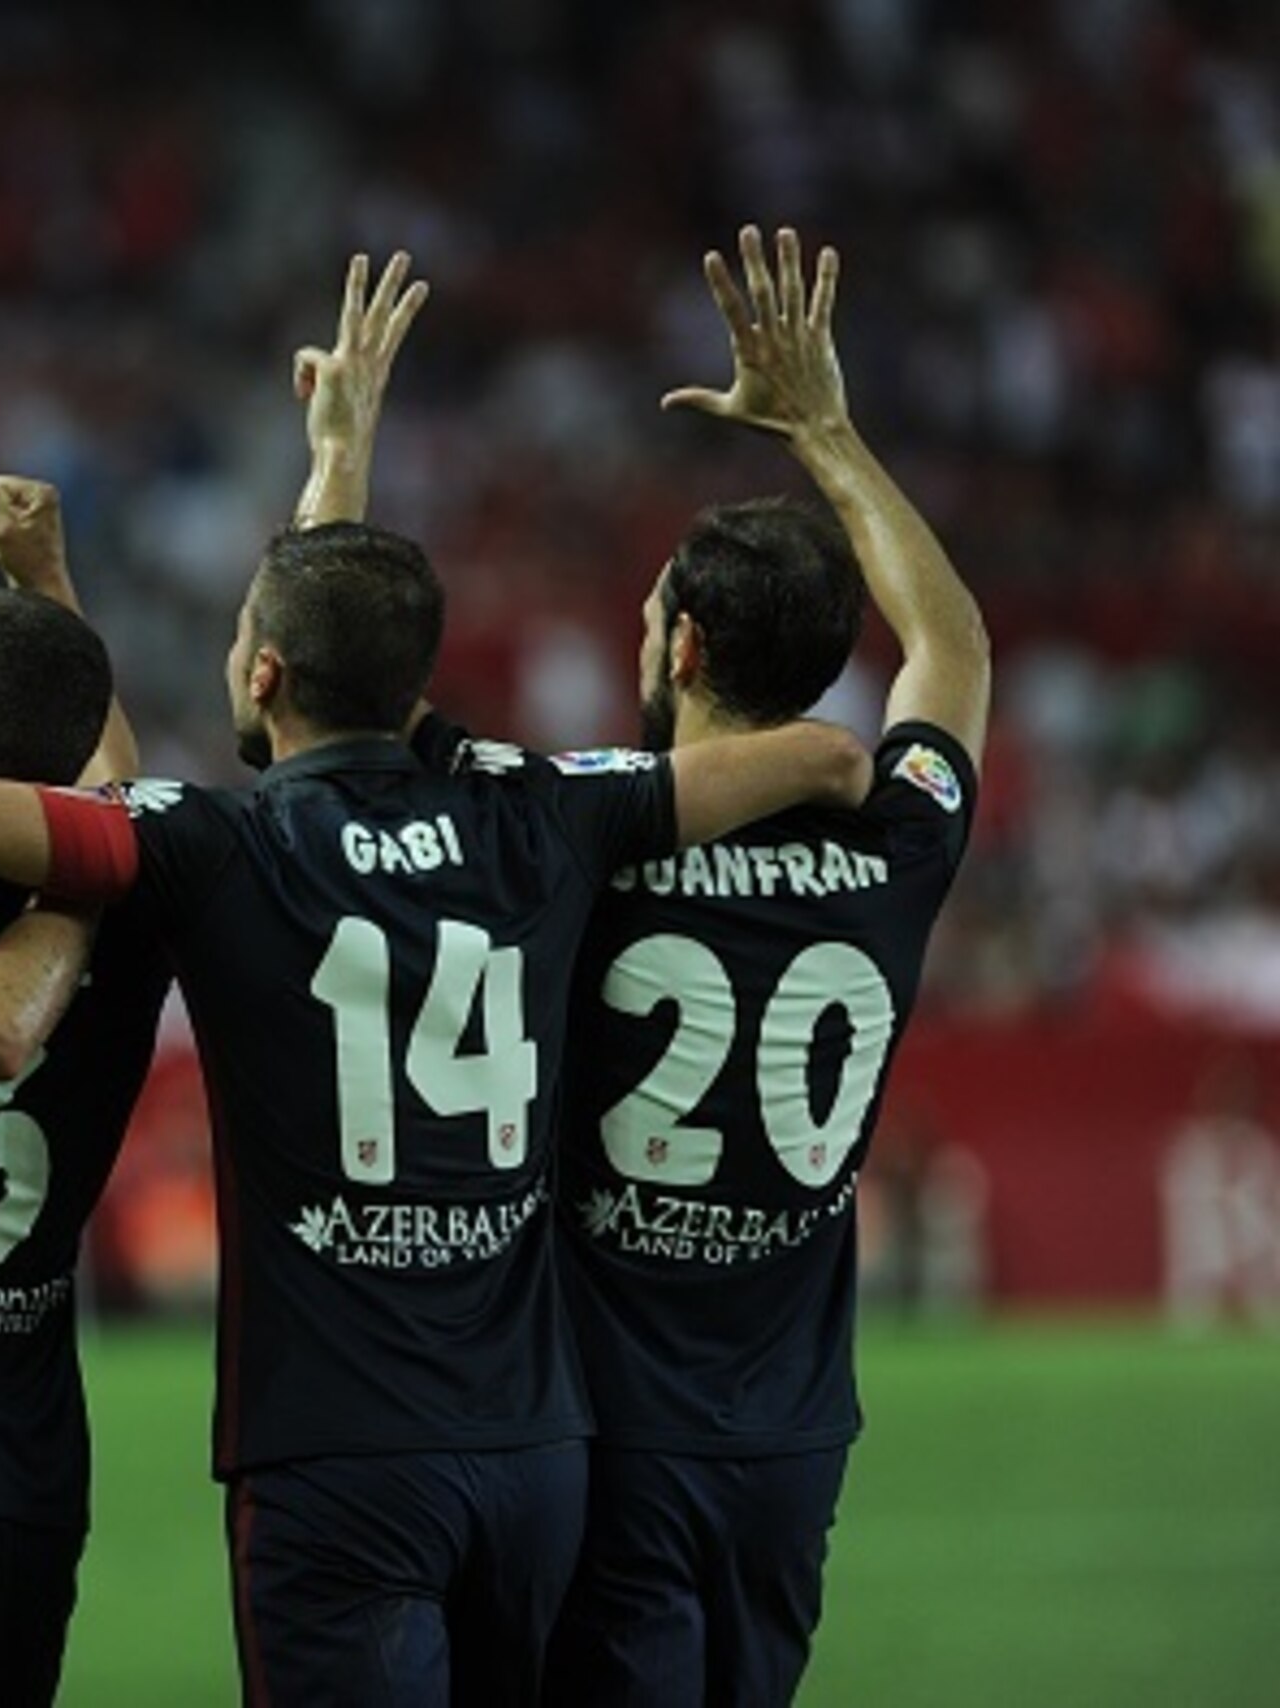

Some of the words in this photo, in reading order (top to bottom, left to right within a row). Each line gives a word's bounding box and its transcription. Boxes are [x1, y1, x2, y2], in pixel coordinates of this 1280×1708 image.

[340, 815, 464, 874] GABI
[311, 917, 537, 1184] 14
[602, 933, 895, 1187] 20
[337, 1244, 412, 1269] LAND
[621, 1229, 694, 1260] LAND
[703, 1243, 741, 1265] OF
